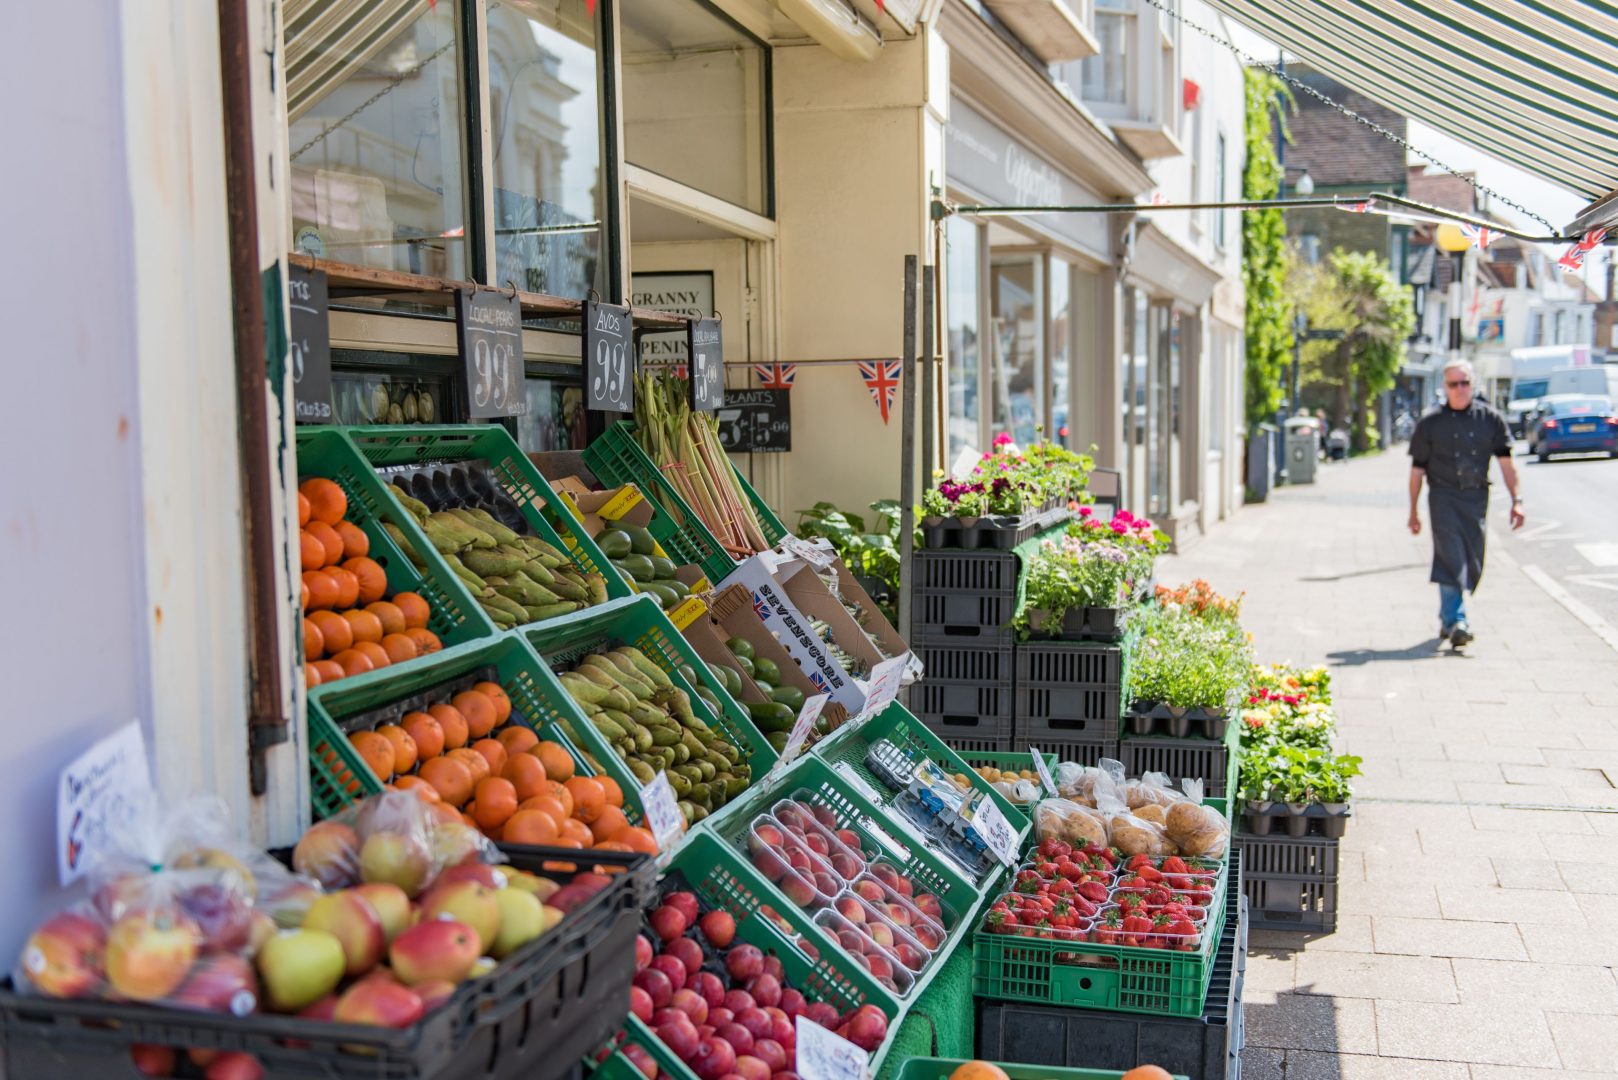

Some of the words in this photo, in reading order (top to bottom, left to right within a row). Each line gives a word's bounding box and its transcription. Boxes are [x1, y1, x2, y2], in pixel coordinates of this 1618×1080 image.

[632, 291, 698, 305] GRANNY
[469, 304, 493, 324] LOCAL
[597, 309, 620, 332] AVOS
[641, 340, 688, 355] PENIN
[475, 339, 509, 409] 99
[759, 584, 844, 689] SEVENSCORE
